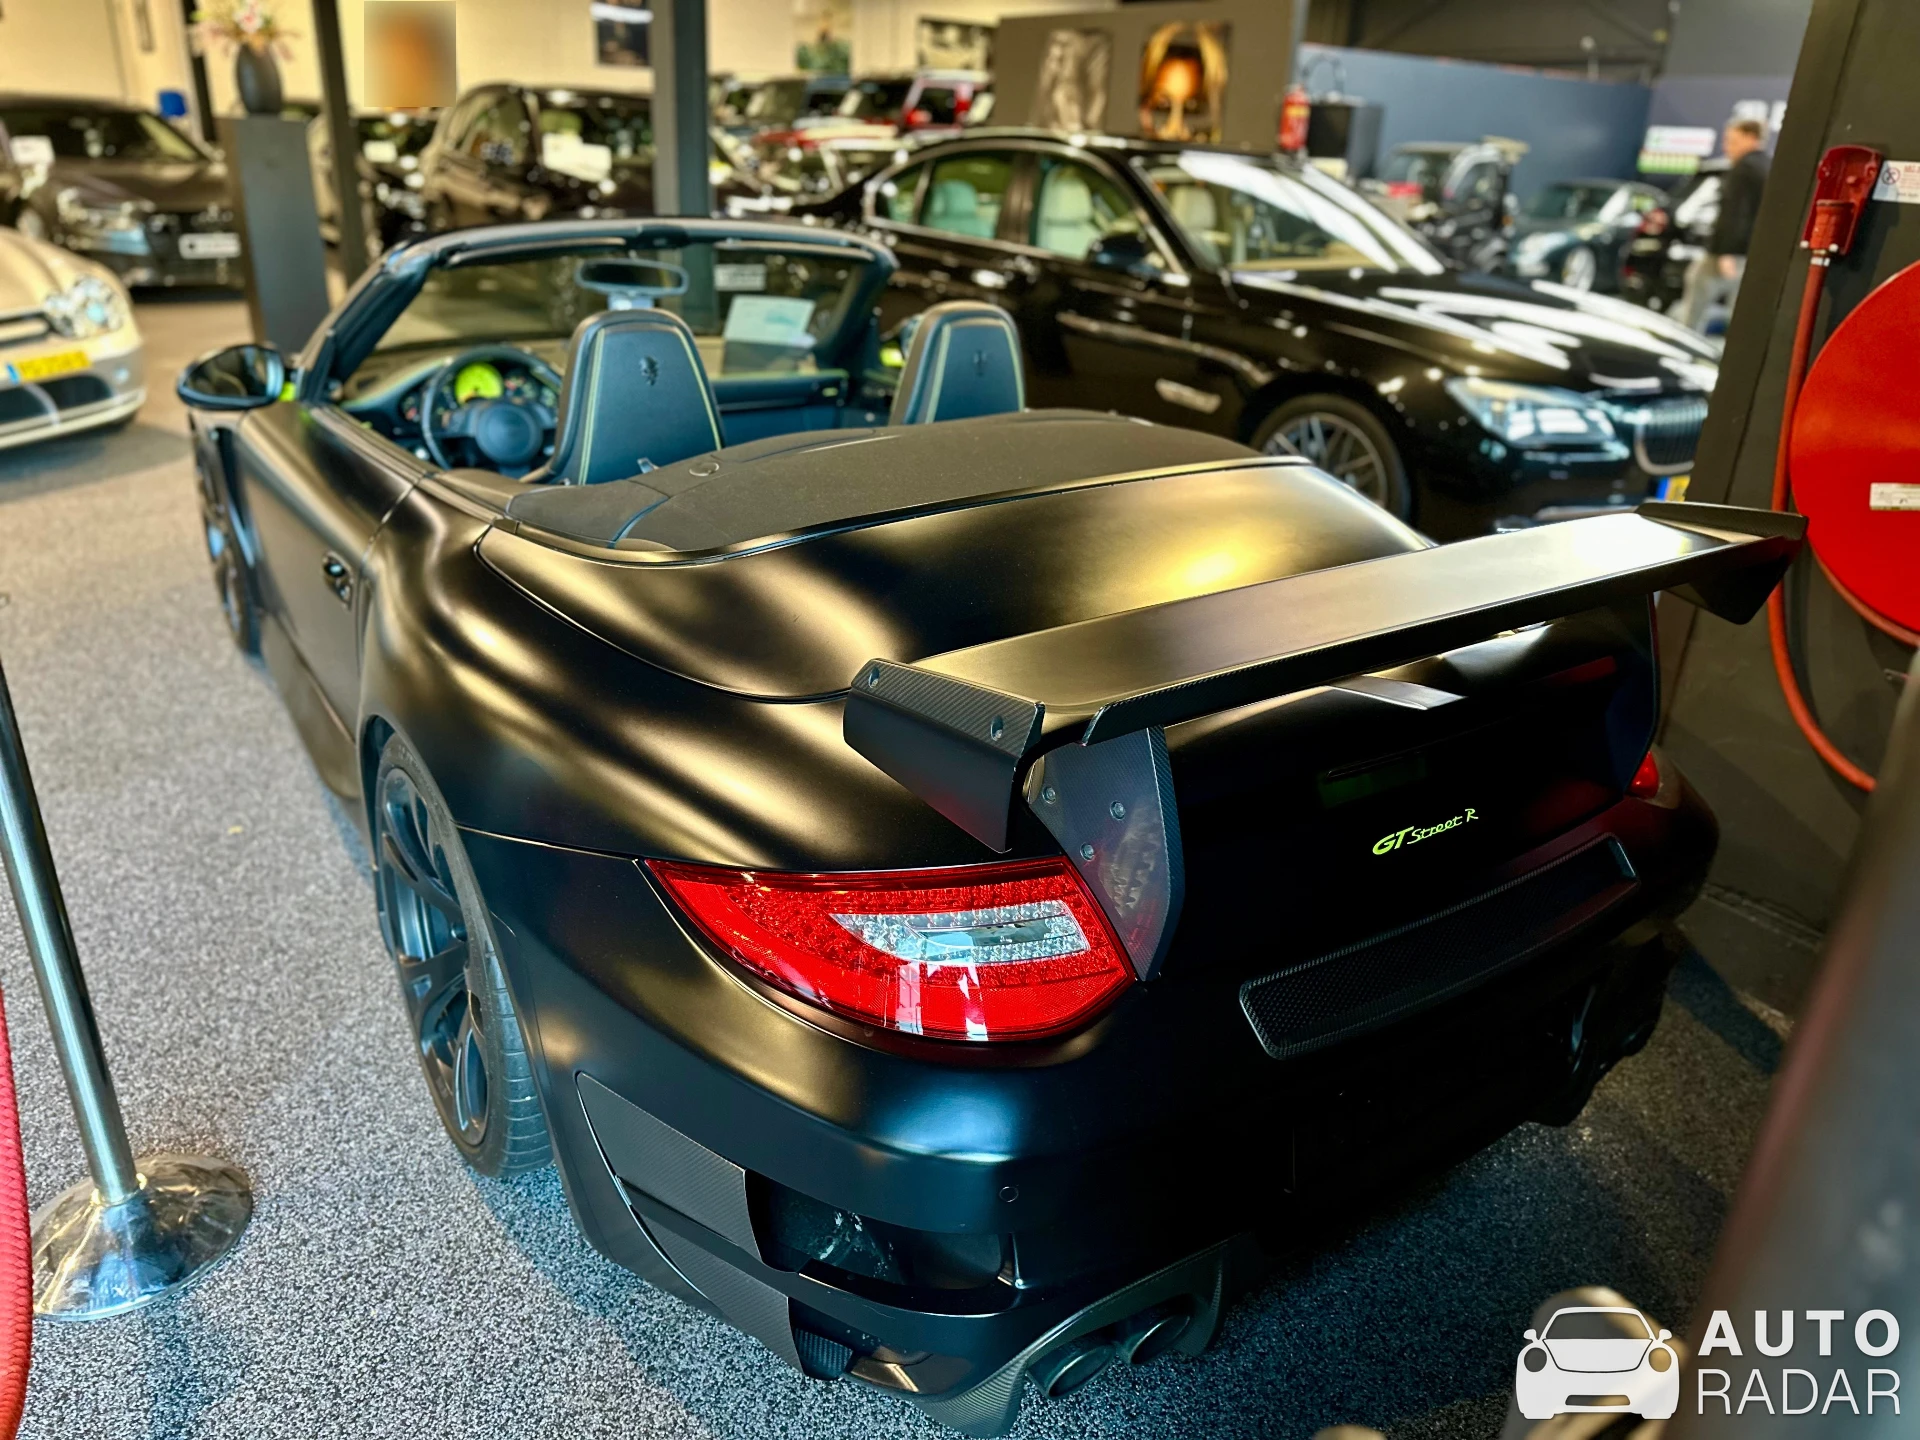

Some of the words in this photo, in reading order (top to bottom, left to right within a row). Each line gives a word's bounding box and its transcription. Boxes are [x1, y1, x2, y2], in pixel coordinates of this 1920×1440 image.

[1372, 826, 1414, 855] GT
[1407, 816, 1463, 845] Street
[1465, 808, 1479, 822] R
